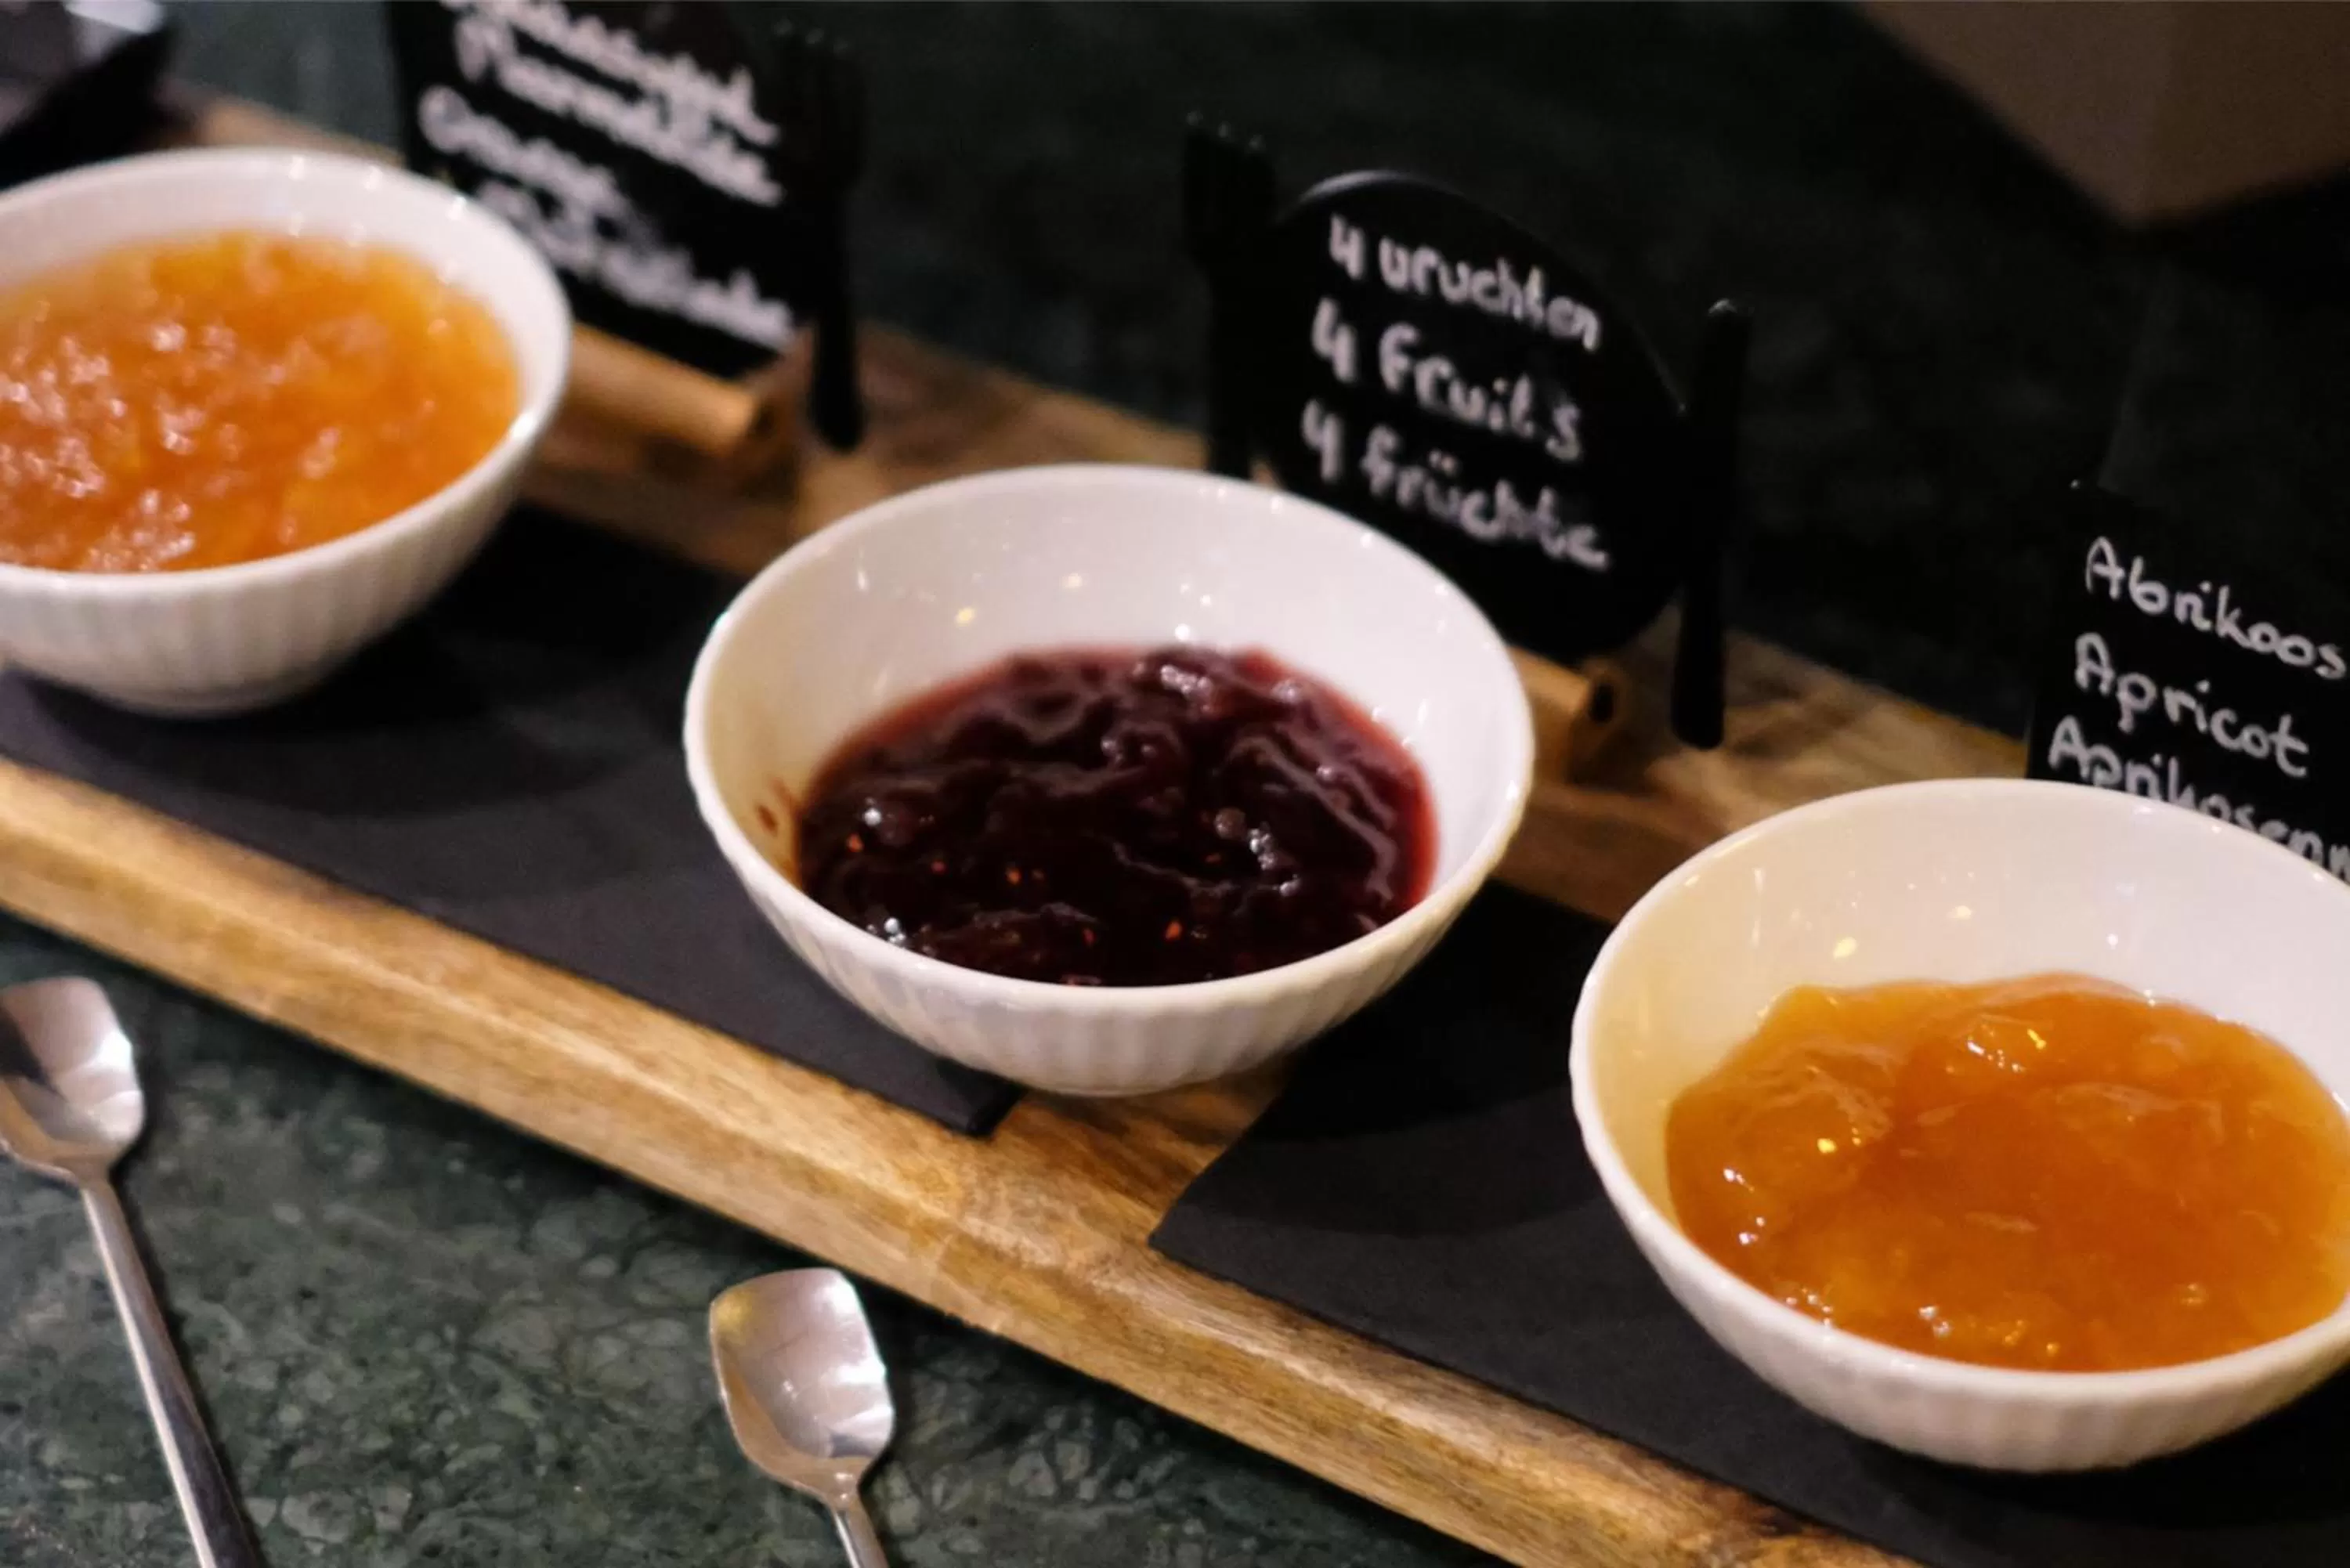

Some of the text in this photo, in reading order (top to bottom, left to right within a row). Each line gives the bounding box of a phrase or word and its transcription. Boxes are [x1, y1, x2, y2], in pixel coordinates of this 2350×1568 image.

[1329, 213, 1364, 281] 4
[1313, 298, 1357, 384] 4
[1301, 399, 1343, 482] 4
[2084, 536, 2346, 679] Abrikoos
[2074, 632, 2309, 777] Apricot
